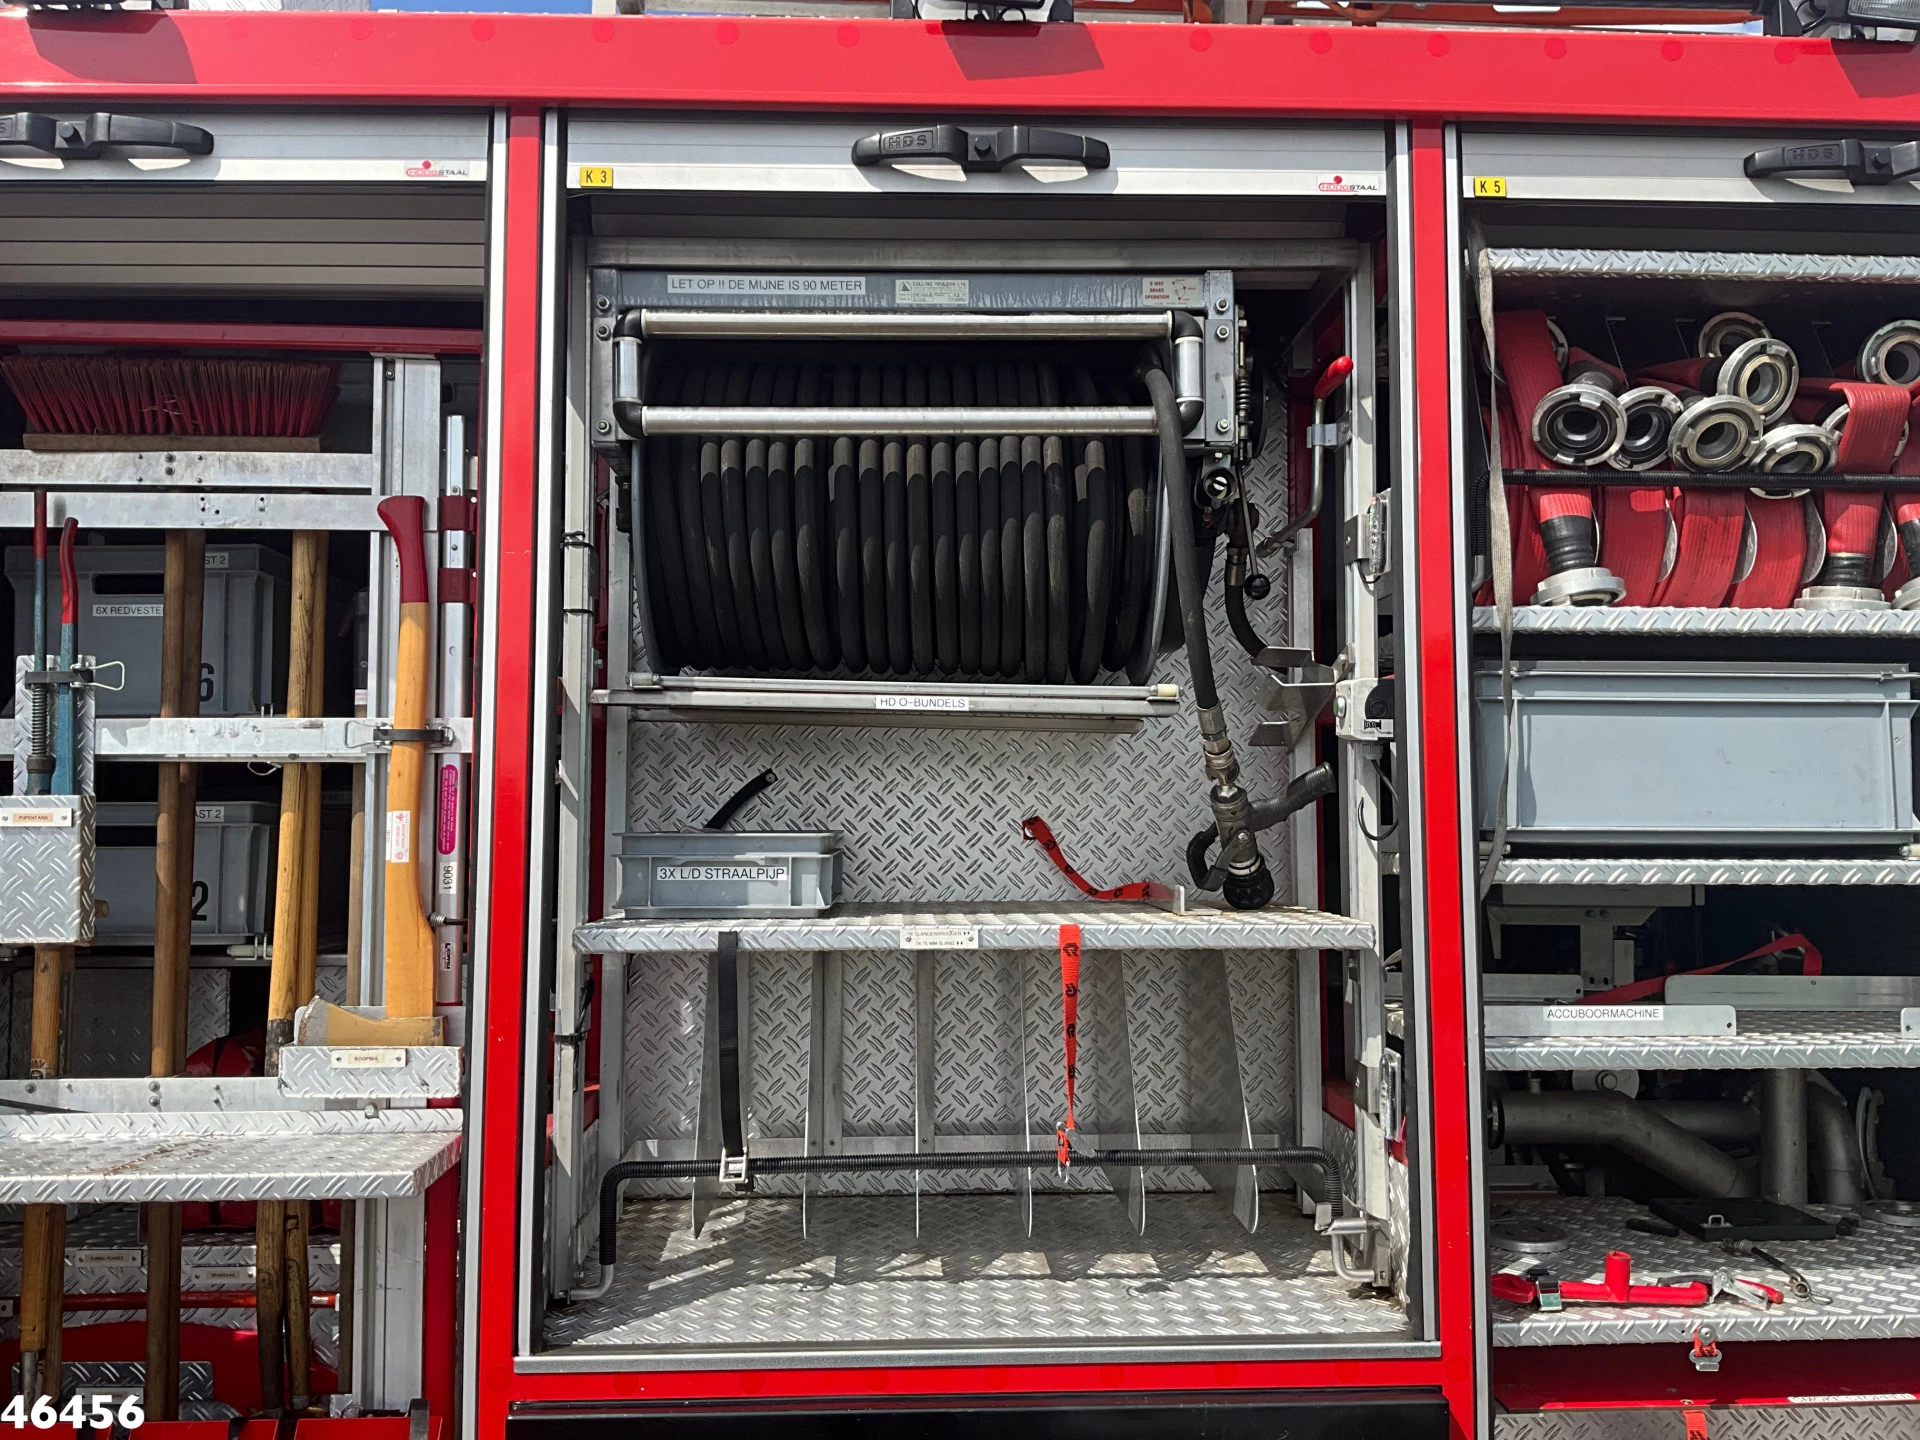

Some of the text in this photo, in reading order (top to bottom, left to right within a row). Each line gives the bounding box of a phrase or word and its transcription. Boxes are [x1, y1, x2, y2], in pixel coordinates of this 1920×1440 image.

[888, 134, 928, 149] HDS
[1792, 147, 1834, 161] HDS
[586, 170, 607, 183] K 3
[1480, 180, 1501, 193] K 5
[671, 278, 694, 289] LET
[697, 278, 715, 290] OP
[728, 279, 745, 290] DE
[748, 279, 785, 290] MIJNE
[788, 280, 800, 291] IS
[802, 280, 817, 291] 90
[820, 280, 862, 291] METER
[205, 556, 226, 565] ST 2
[95, 606, 162, 615] 6X REDVESTE
[880, 697, 966, 708] HD O-BUNDELS
[194, 809, 222, 819] AST 2
[442, 865, 454, 891] 9031
[659, 867, 785, 880] 3X L/D STRAALPIJP
[191, 880, 209, 921] 2
[1547, 1008, 1660, 1019] ACCUBOORMACHINE
